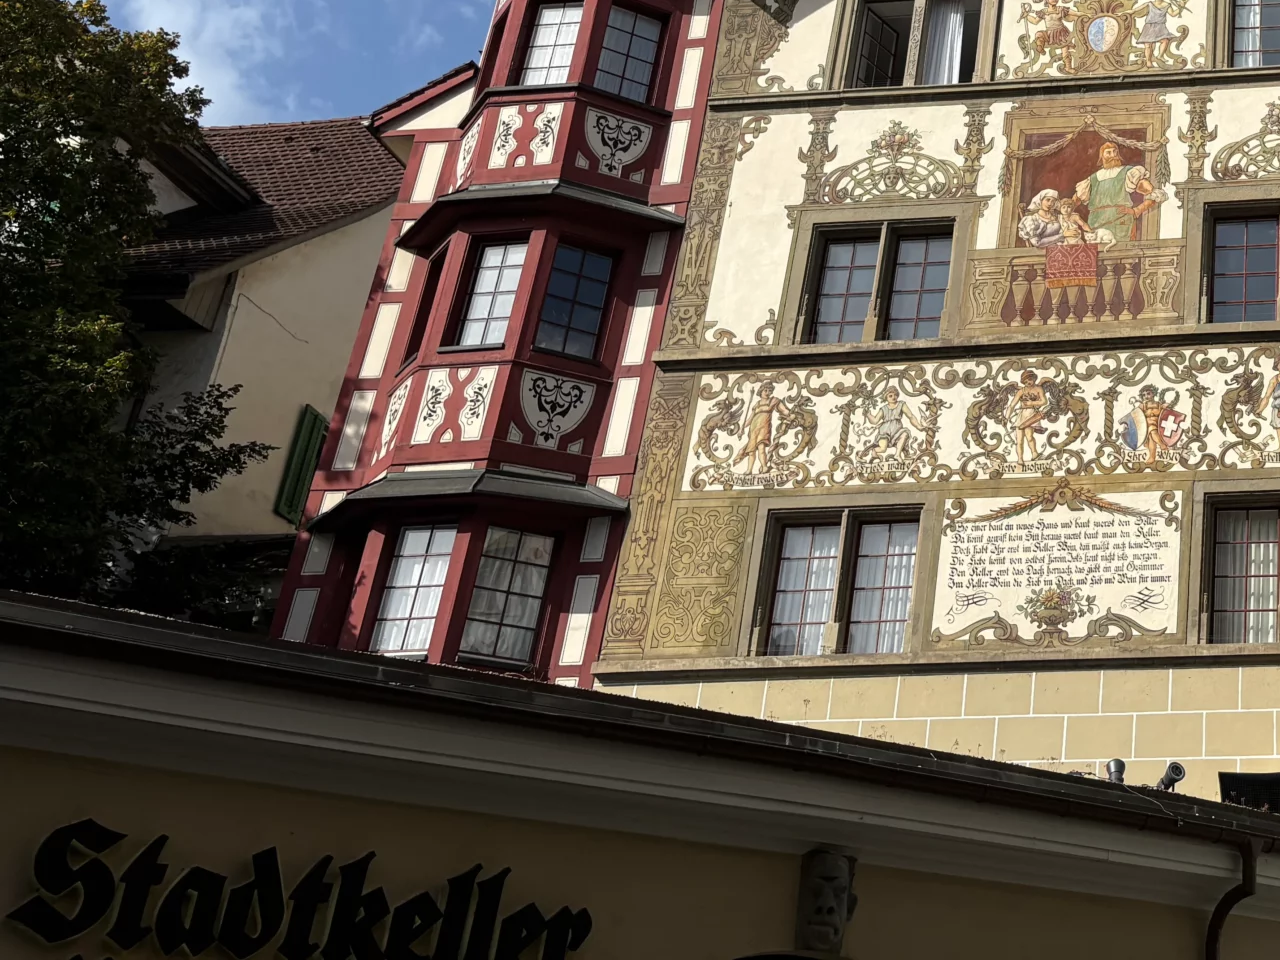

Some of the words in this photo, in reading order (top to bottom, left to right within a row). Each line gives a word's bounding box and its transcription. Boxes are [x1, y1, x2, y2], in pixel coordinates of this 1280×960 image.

[971, 523, 987, 532] einer
[1004, 522, 1014, 531] ein
[1035, 518, 1059, 531] Haus
[1060, 519, 1072, 529] und
[1118, 518, 1130, 526] den
[1101, 531, 1117, 539] man
[1119, 529, 1131, 538] den
[948, 566, 966, 578] Den
[968, 566, 994, 577] Keller
[1011, 566, 1025, 576] das
[4, 817, 594, 960] Stadtkeller
